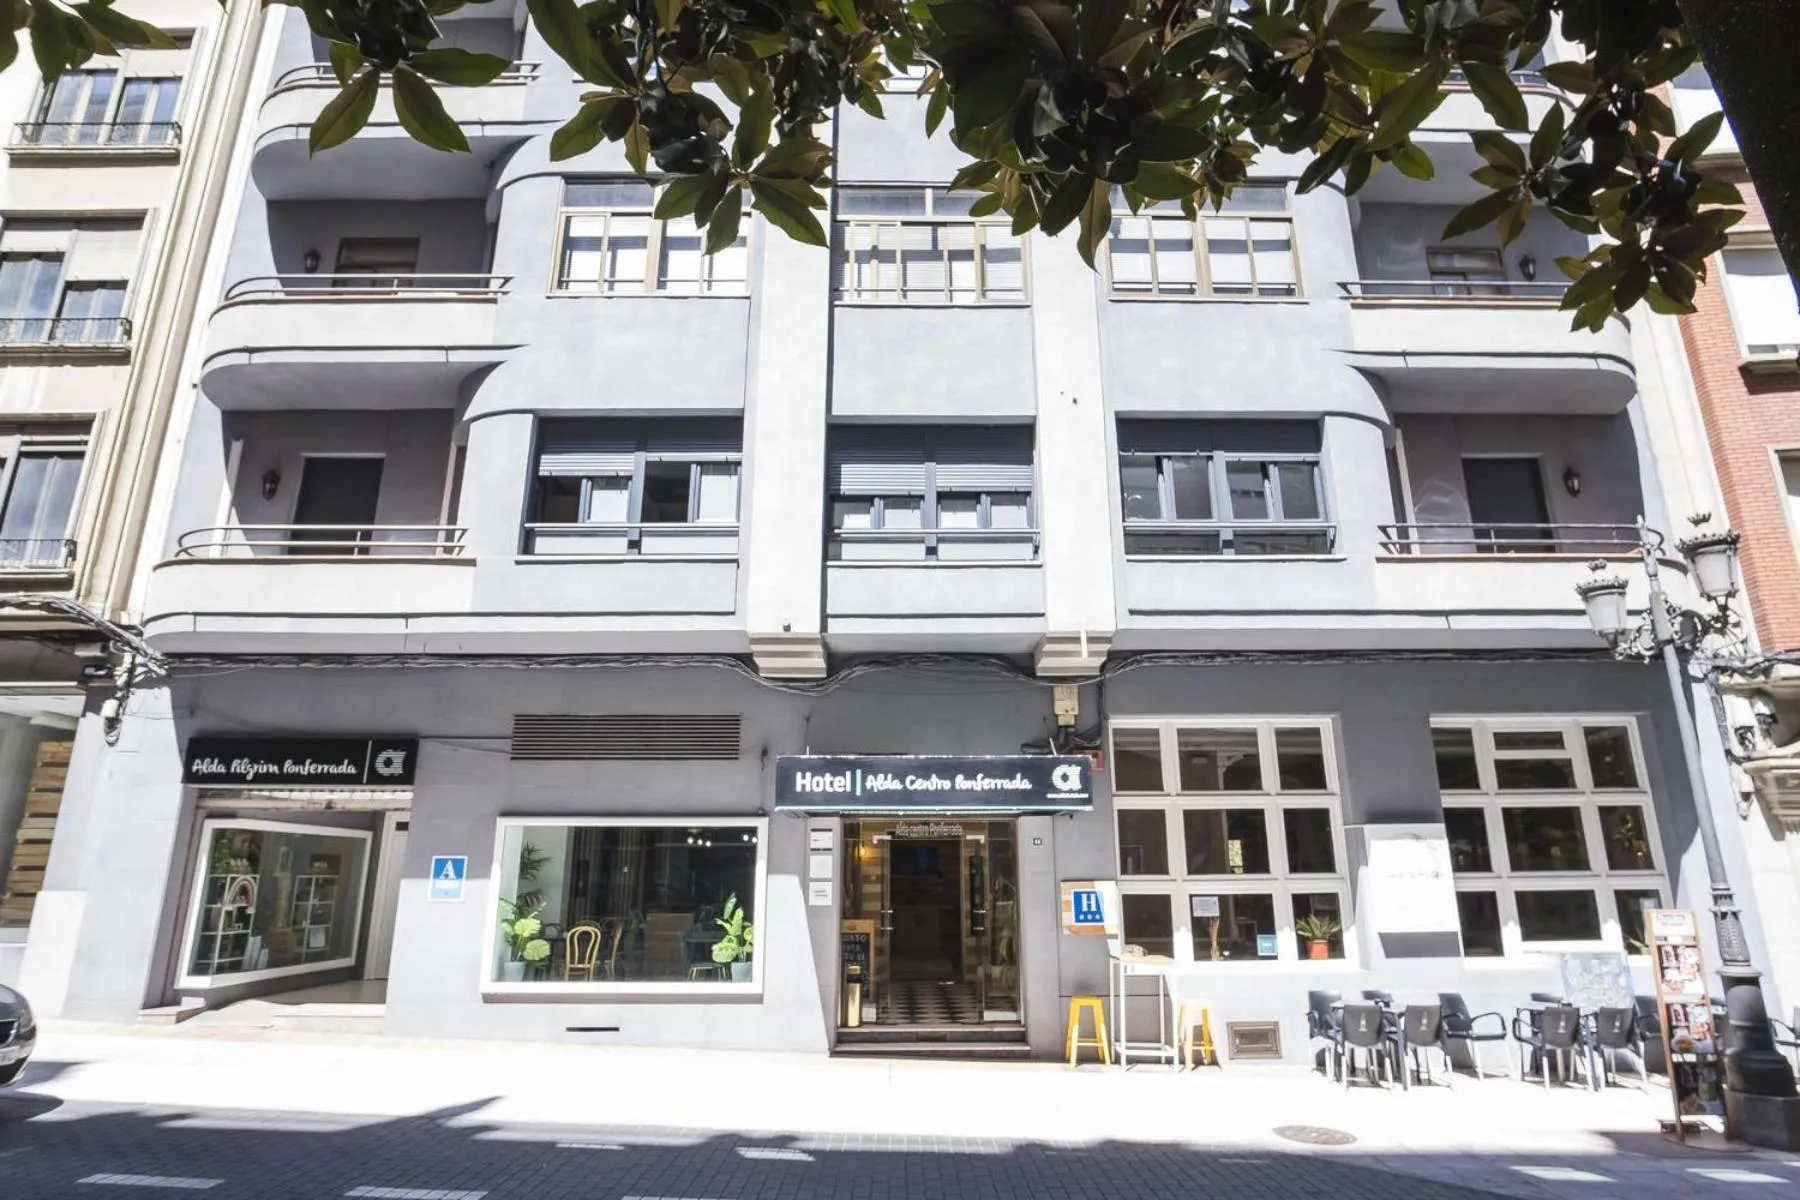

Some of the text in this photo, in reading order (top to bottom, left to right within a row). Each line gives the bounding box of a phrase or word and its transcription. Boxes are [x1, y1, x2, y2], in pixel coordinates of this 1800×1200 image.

[192, 758, 357, 780] Alda Pilgrim Ponferrada
[795, 770, 1033, 792] Hotel Alda Centro Ponferrada
[439, 860, 457, 880] A
[1081, 893, 1098, 912] H
